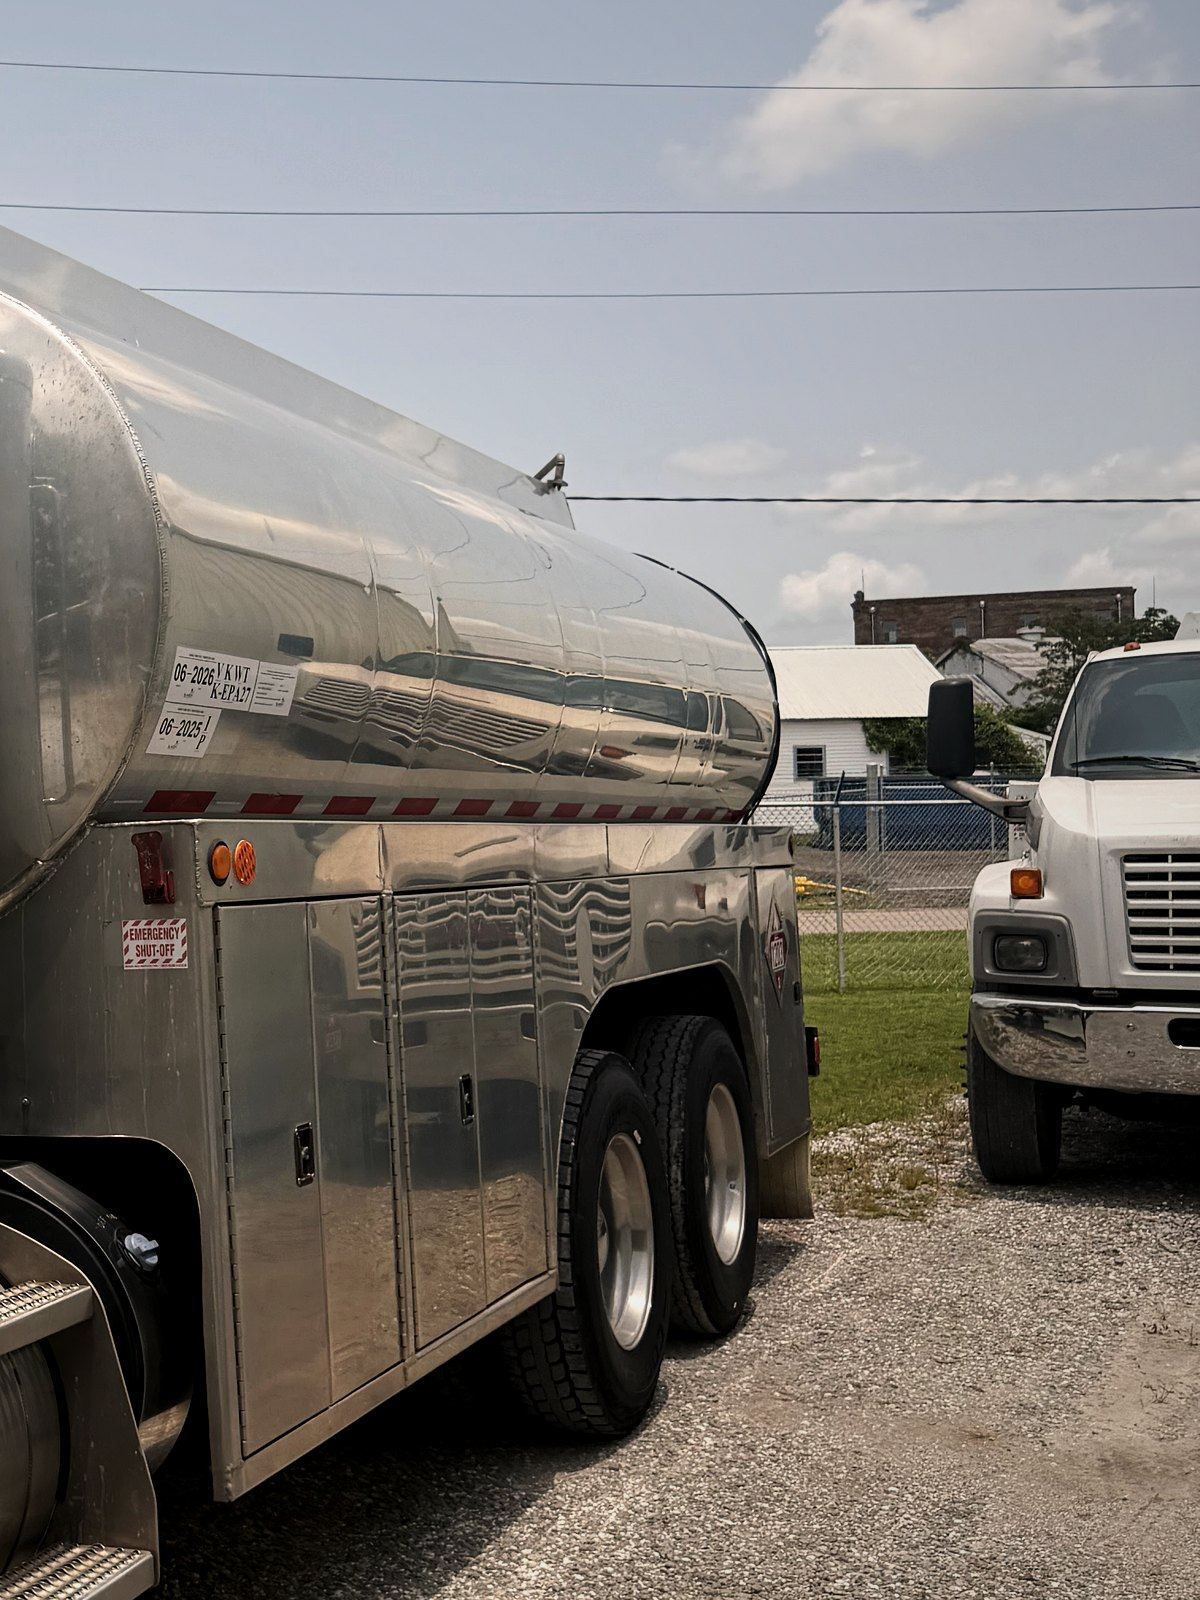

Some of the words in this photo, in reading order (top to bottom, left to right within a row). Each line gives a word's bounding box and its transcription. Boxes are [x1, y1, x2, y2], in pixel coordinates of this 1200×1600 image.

[173, 662, 216, 687] 06-2026
[158, 717, 204, 739] 06-2025
[129, 926, 180, 941] EMERGENCY
